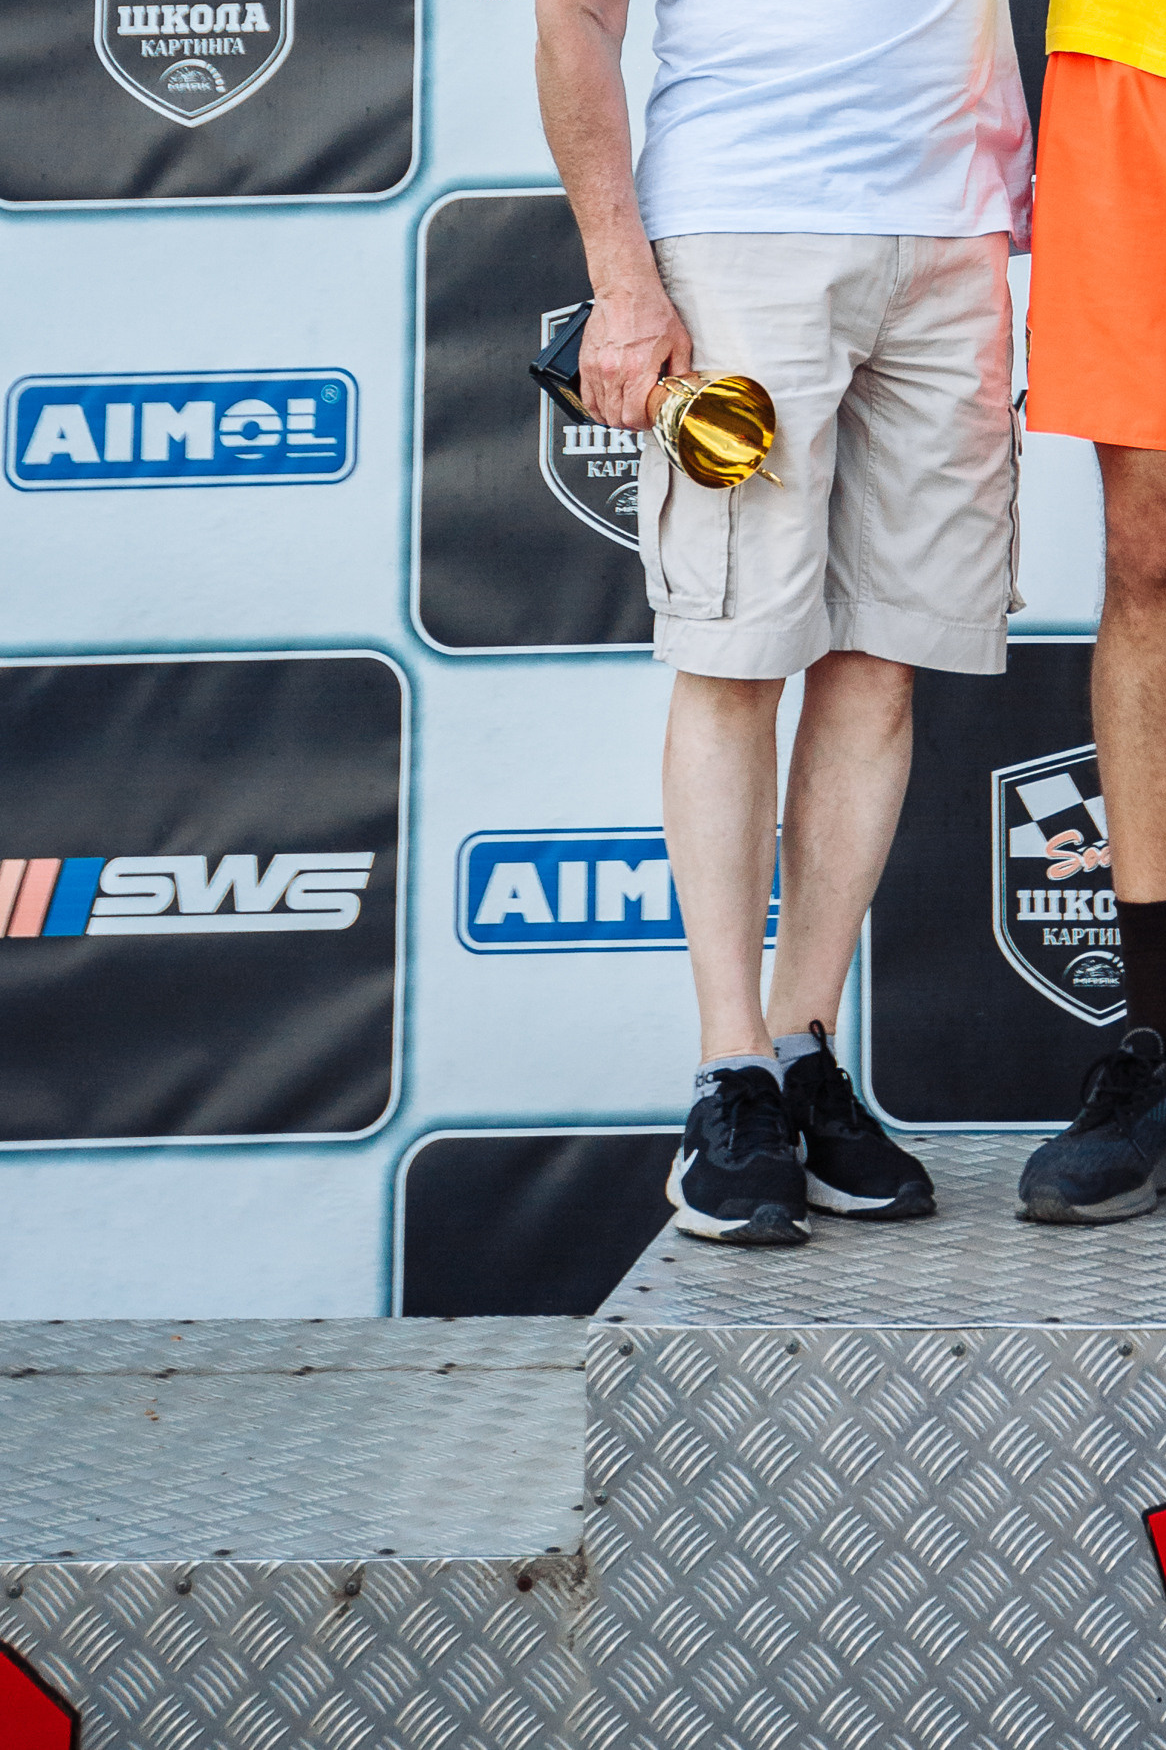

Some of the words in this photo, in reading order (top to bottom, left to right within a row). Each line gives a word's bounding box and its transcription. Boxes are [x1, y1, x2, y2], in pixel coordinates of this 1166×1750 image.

[117, 3, 270, 35] ШКОЛА
[141, 37, 246, 57] КАРТИНГА
[22, 398, 338, 465] AIMOL
[587, 460, 638, 478] КАРТ
[85, 851, 376, 935] SWS
[473, 859, 672, 925] AIM
[1016, 889, 1118, 921] ШКО
[1042, 927, 1122, 945] КАРТИ
